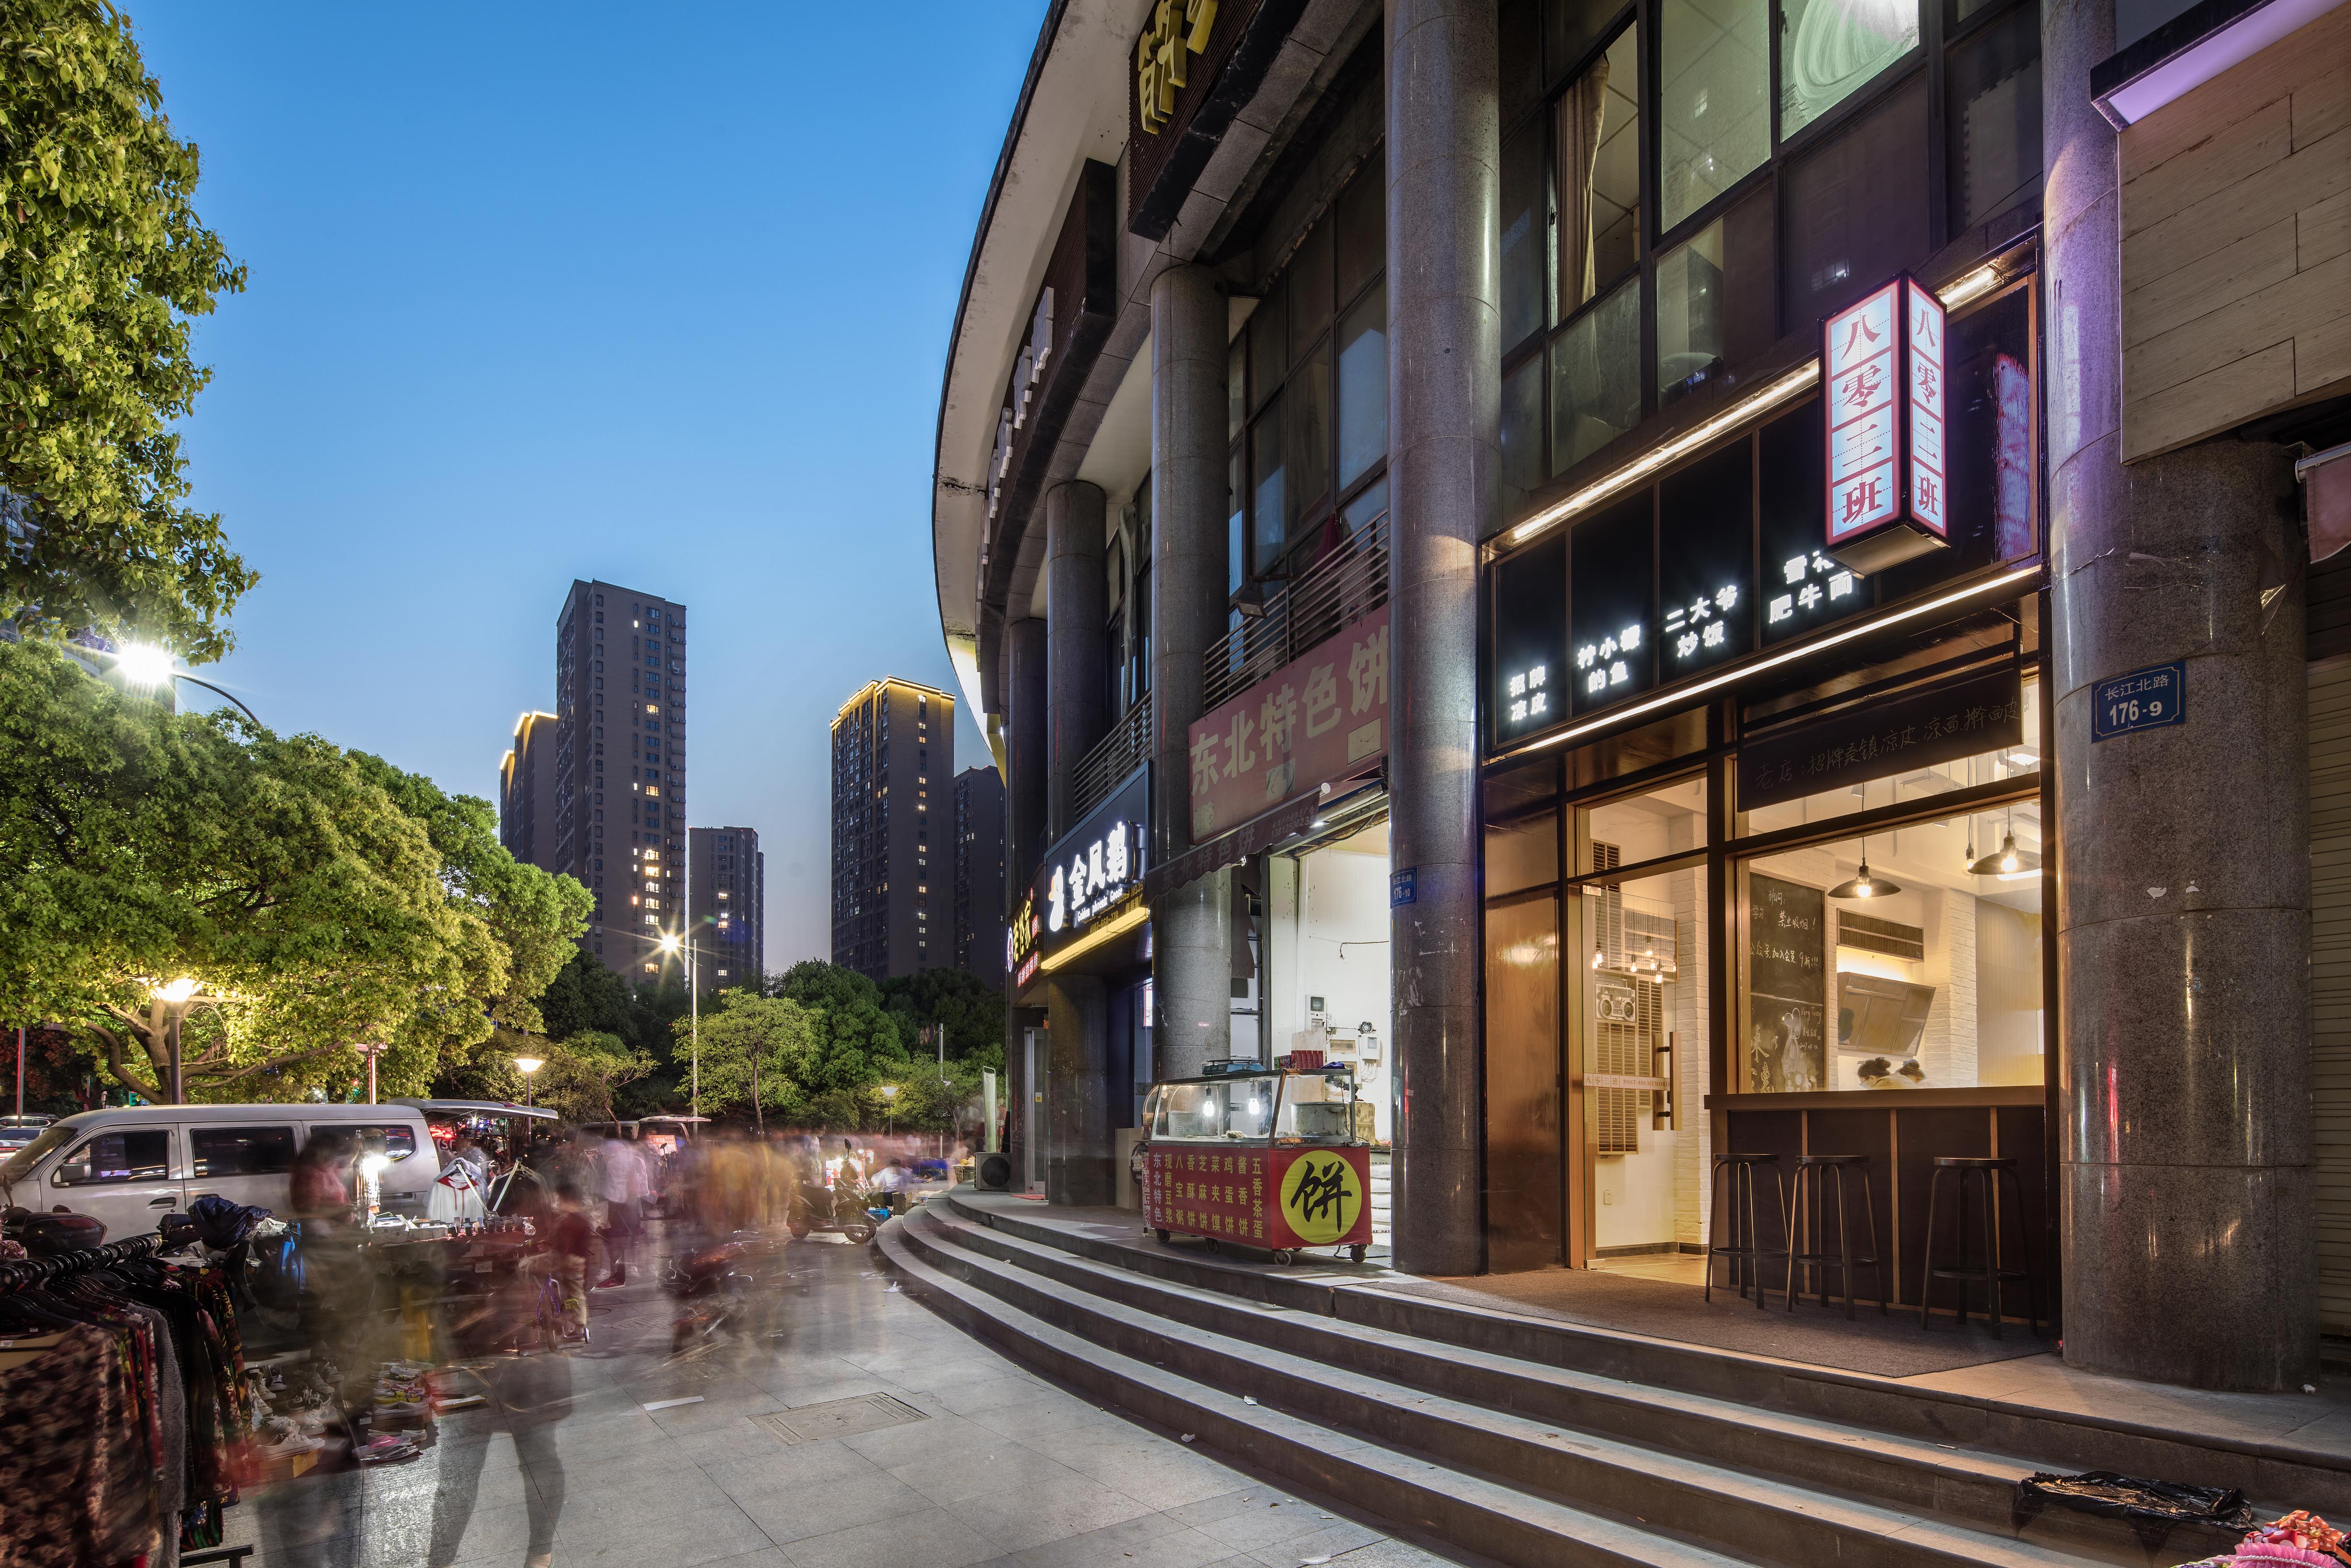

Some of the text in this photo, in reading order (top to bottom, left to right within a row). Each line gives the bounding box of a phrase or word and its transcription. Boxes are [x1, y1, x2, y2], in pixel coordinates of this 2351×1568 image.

[1841, 314, 1883, 524] 八零二班
[1916, 308, 1939, 517] 八零二班
[1665, 585, 1738, 632] 二大爷
[1769, 571, 1853, 624] 肥牛面
[1677, 620, 1725, 658] 炒饭
[1190, 625, 1389, 797] 东北特色饼
[1510, 666, 1546, 698] 招牌
[2105, 674, 2169, 701] 长江北路
[2109, 699, 2162, 726] 176-9
[1162, 824, 1256, 889] 东北特色饼
[1393, 874, 1412, 886] 长江北路
[1393, 885, 1410, 901] 176-10
[1800, 1006, 1810, 1021] Very
[1586, 1075, 1619, 1086] 八零二班
[1153, 1152, 1163, 1223] 东北特色
[1164, 1153, 1174, 1224] 现磨豆浆
[1175, 1154, 1184, 1226] 八宝粥
[1186, 1154, 1196, 1228] 香酥饼
[1198, 1154, 1208, 1230] 芝麻饼
[1211, 1155, 1221, 1232] 菜夹馍
[1224, 1155, 1234, 1235] 鸡蛋饼
[1237, 1156, 1248, 1237] 酱香饼
[1252, 1157, 1263, 1239] 五香茶蛋
[1290, 1159, 1352, 1233] 饼
